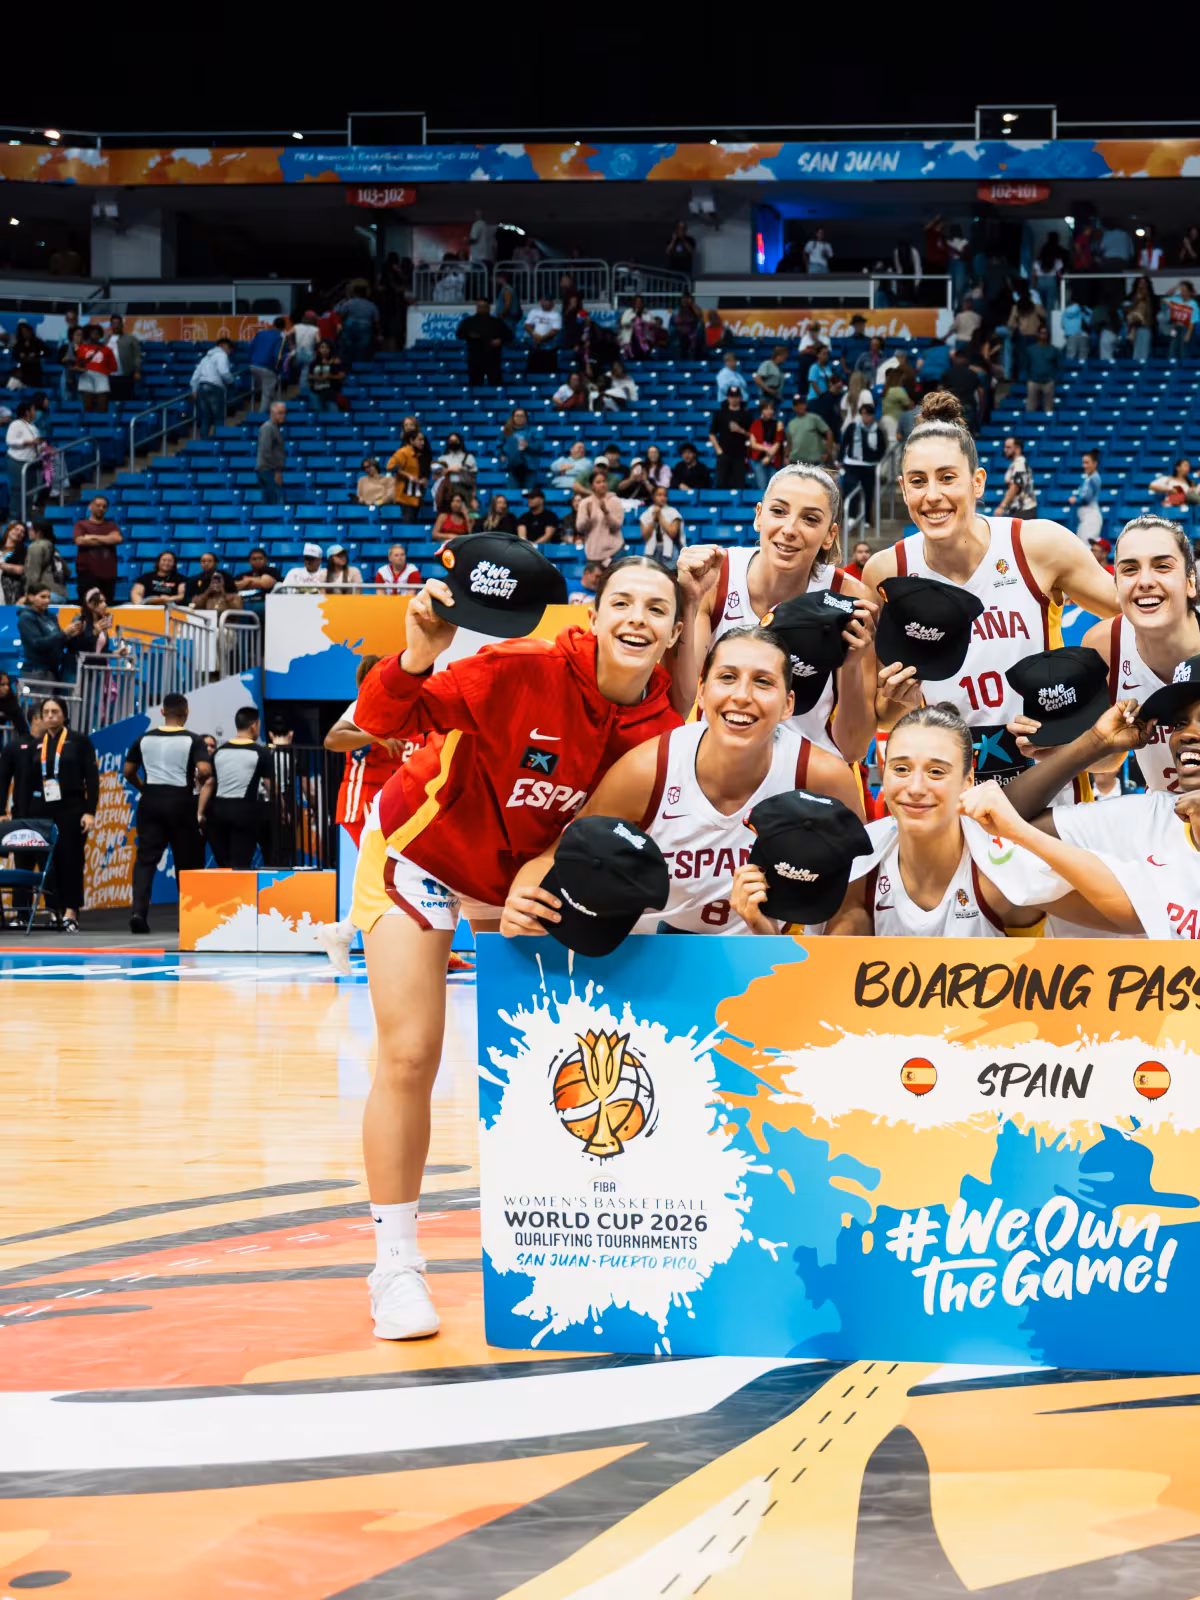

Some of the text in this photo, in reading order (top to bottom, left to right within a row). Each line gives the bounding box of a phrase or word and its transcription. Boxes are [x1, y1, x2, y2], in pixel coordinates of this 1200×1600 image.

[797, 150, 902, 173] SAN JUAN
[357, 188, 405, 203] 103-102
[477, 560, 511, 579] #We
[470, 580, 515, 600] Game!
[968, 605, 1031, 645] AÑA
[958, 670, 1005, 711] 10
[1037, 683, 1065, 699] #We
[505, 777, 588, 815] ESPA
[700, 898, 732, 927] 8
[854, 960, 1095, 1010] BOARDING
[977, 1062, 1094, 1099] SPAIN
[593, 1181, 617, 1193] FIBA
[504, 1194, 709, 1211] WOMEN'S BASKETBALL
[504, 1210, 709, 1232] WORLD CUP 2026
[514, 1232, 698, 1251] QUALIFYING TOURNAMENTS
[515, 1252, 546, 1267] SAN
[661, 1256, 698, 1270] RICO
